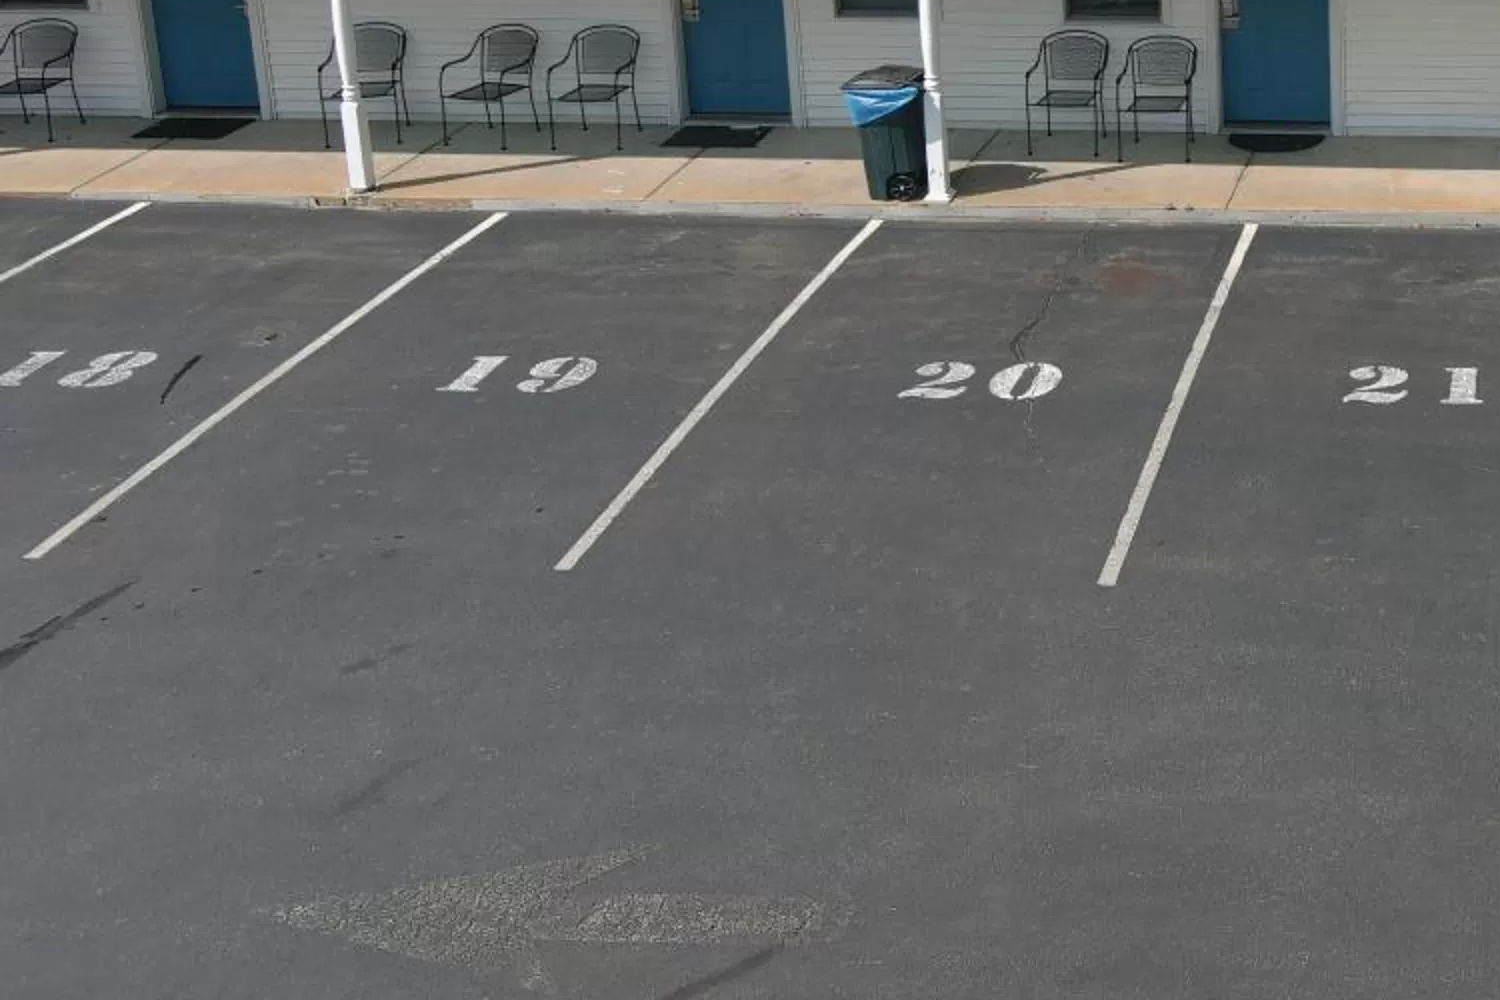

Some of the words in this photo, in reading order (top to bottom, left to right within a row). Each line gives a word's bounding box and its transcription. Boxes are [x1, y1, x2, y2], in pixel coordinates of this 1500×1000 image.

[0, 350, 159, 388] 18
[435, 355, 598, 393] 19
[897, 361, 1063, 401] 20
[1342, 365, 1484, 405] 21
